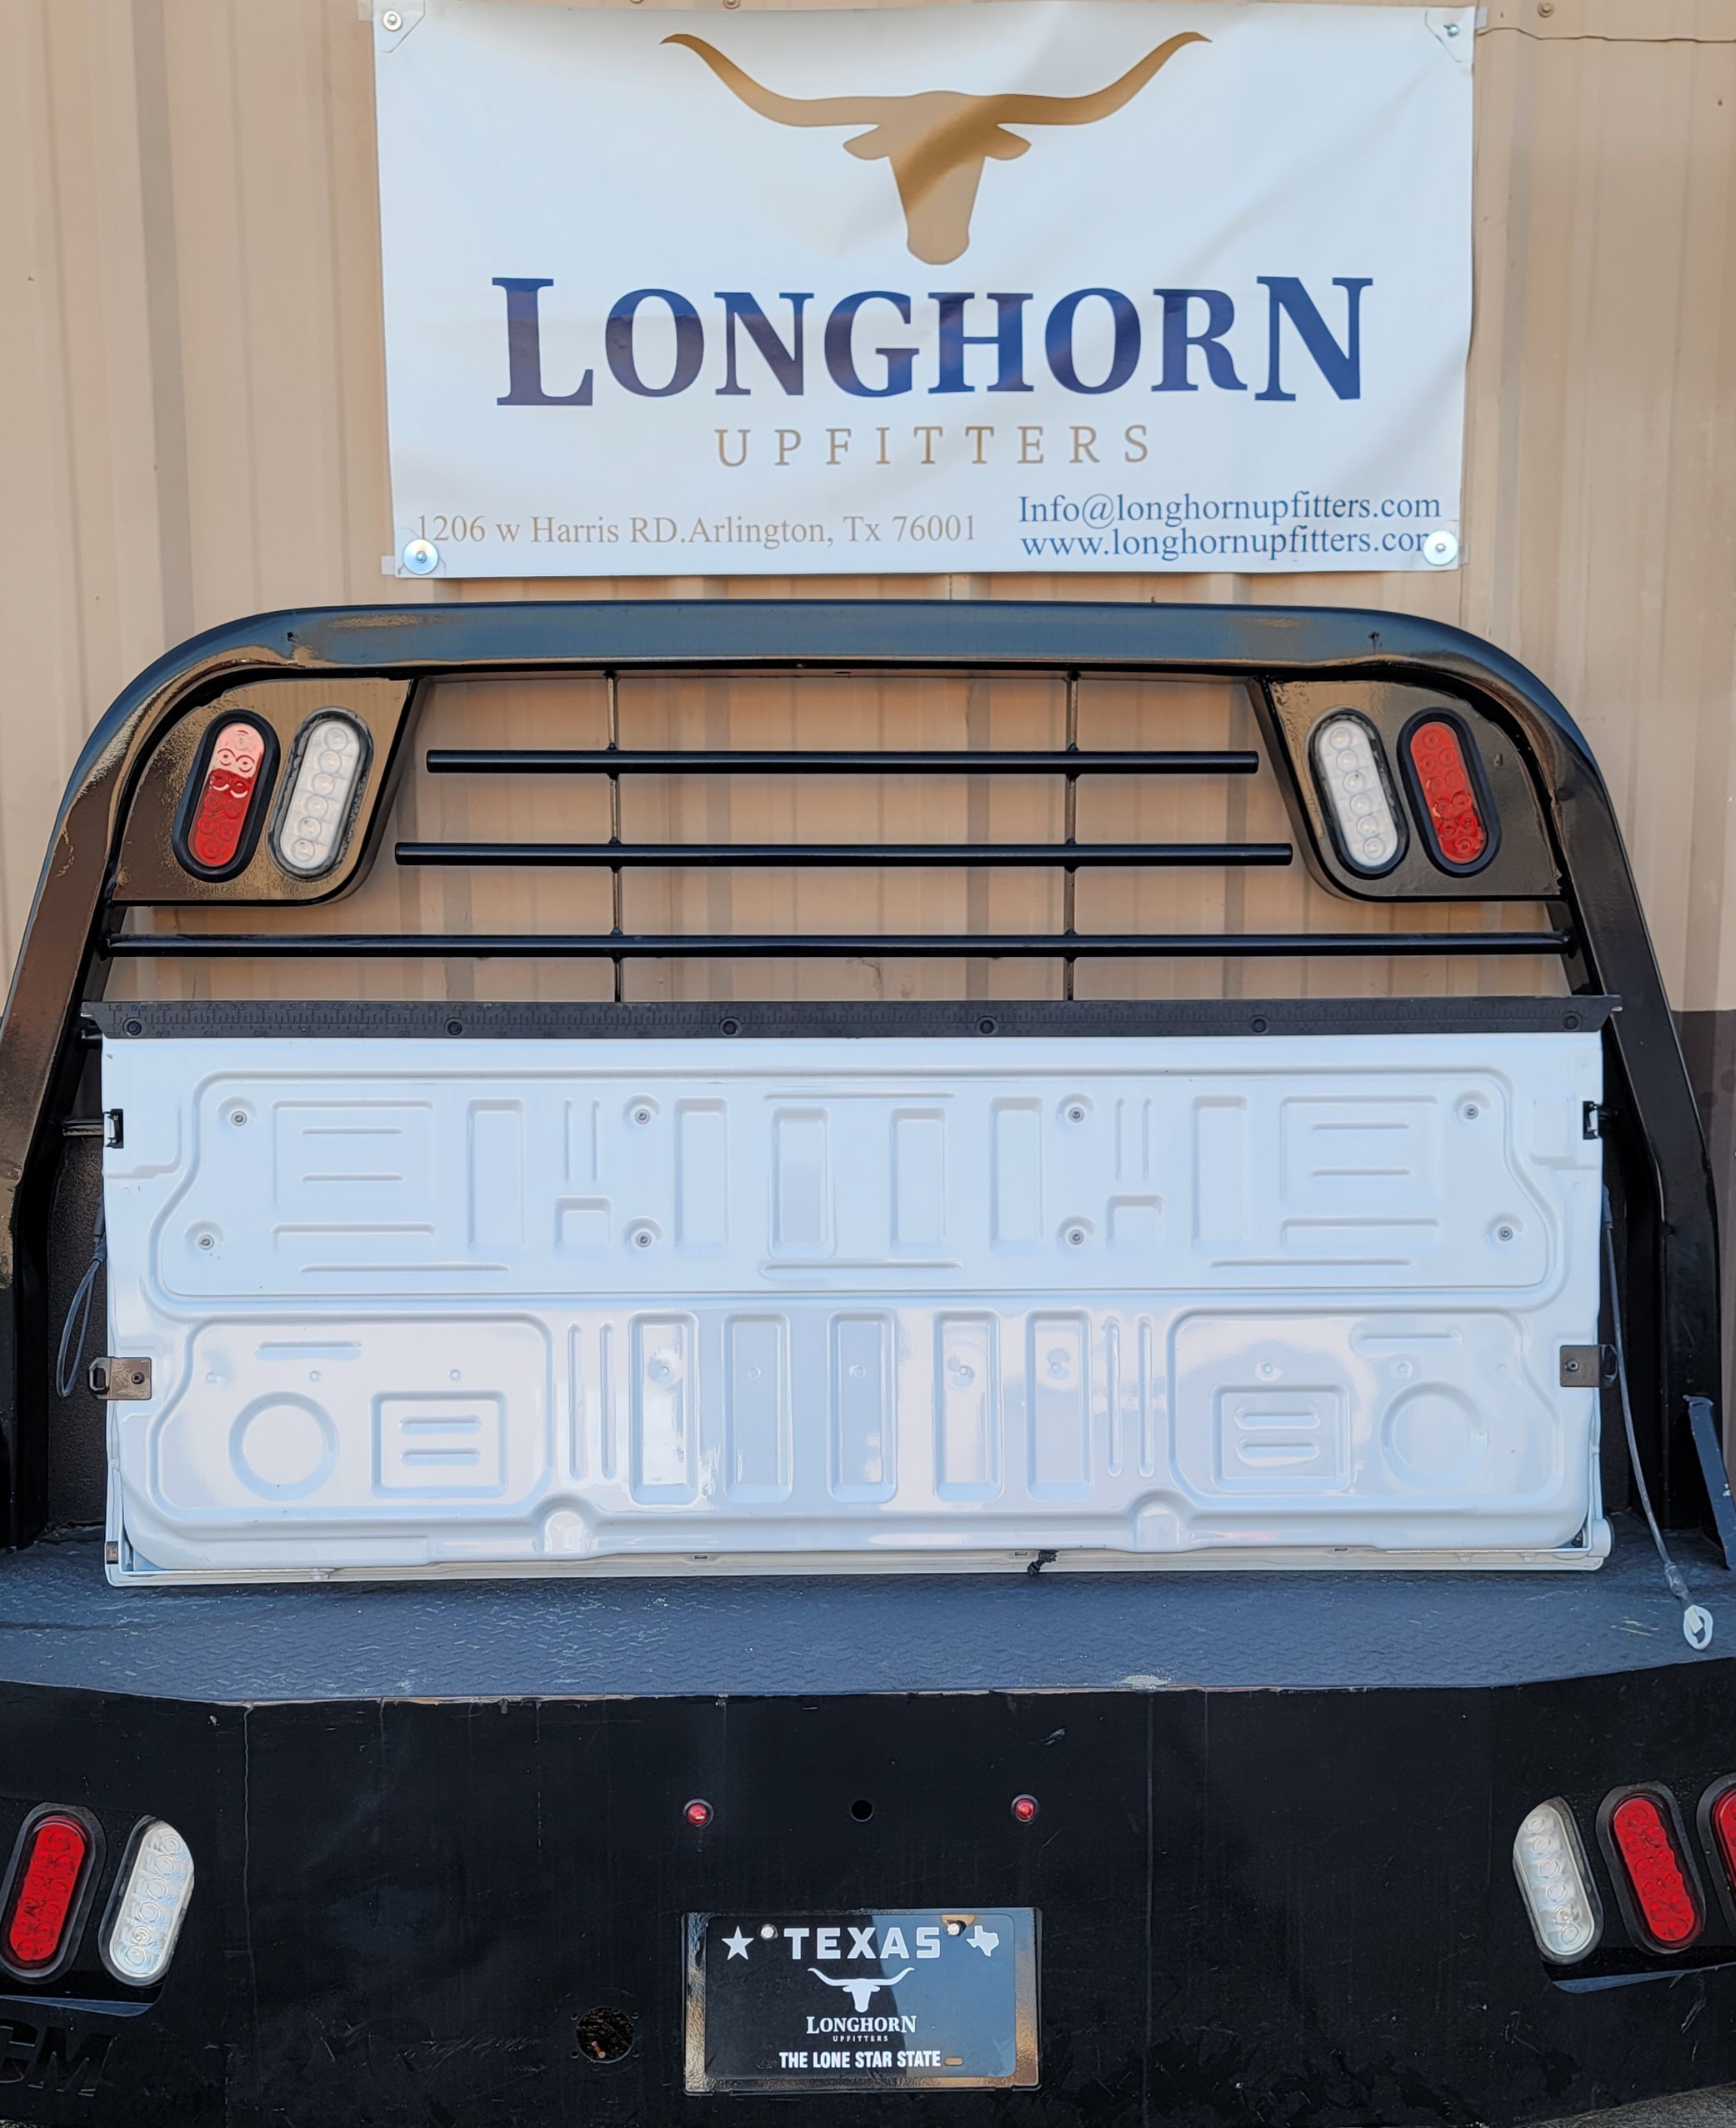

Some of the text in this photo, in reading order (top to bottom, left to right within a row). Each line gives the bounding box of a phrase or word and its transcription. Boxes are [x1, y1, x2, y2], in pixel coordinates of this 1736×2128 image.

[492, 276, 1373, 407] LONGHORN
[715, 424, 1148, 467] UPFITTERS
[1018, 491, 1441, 528] Info@longhornupfitters.com
[418, 514, 486, 542] 1206
[531, 515, 619, 544] Harris
[629, 515, 833, 549] RD.Arlington,
[843, 515, 881, 542] Tx
[893, 513, 976, 543] 76001
[783, 1926, 940, 1960] TEXAS
[806, 2015, 917, 2034] LONGHORN
[779, 2050, 941, 2069] THE LONE STAR STATE
